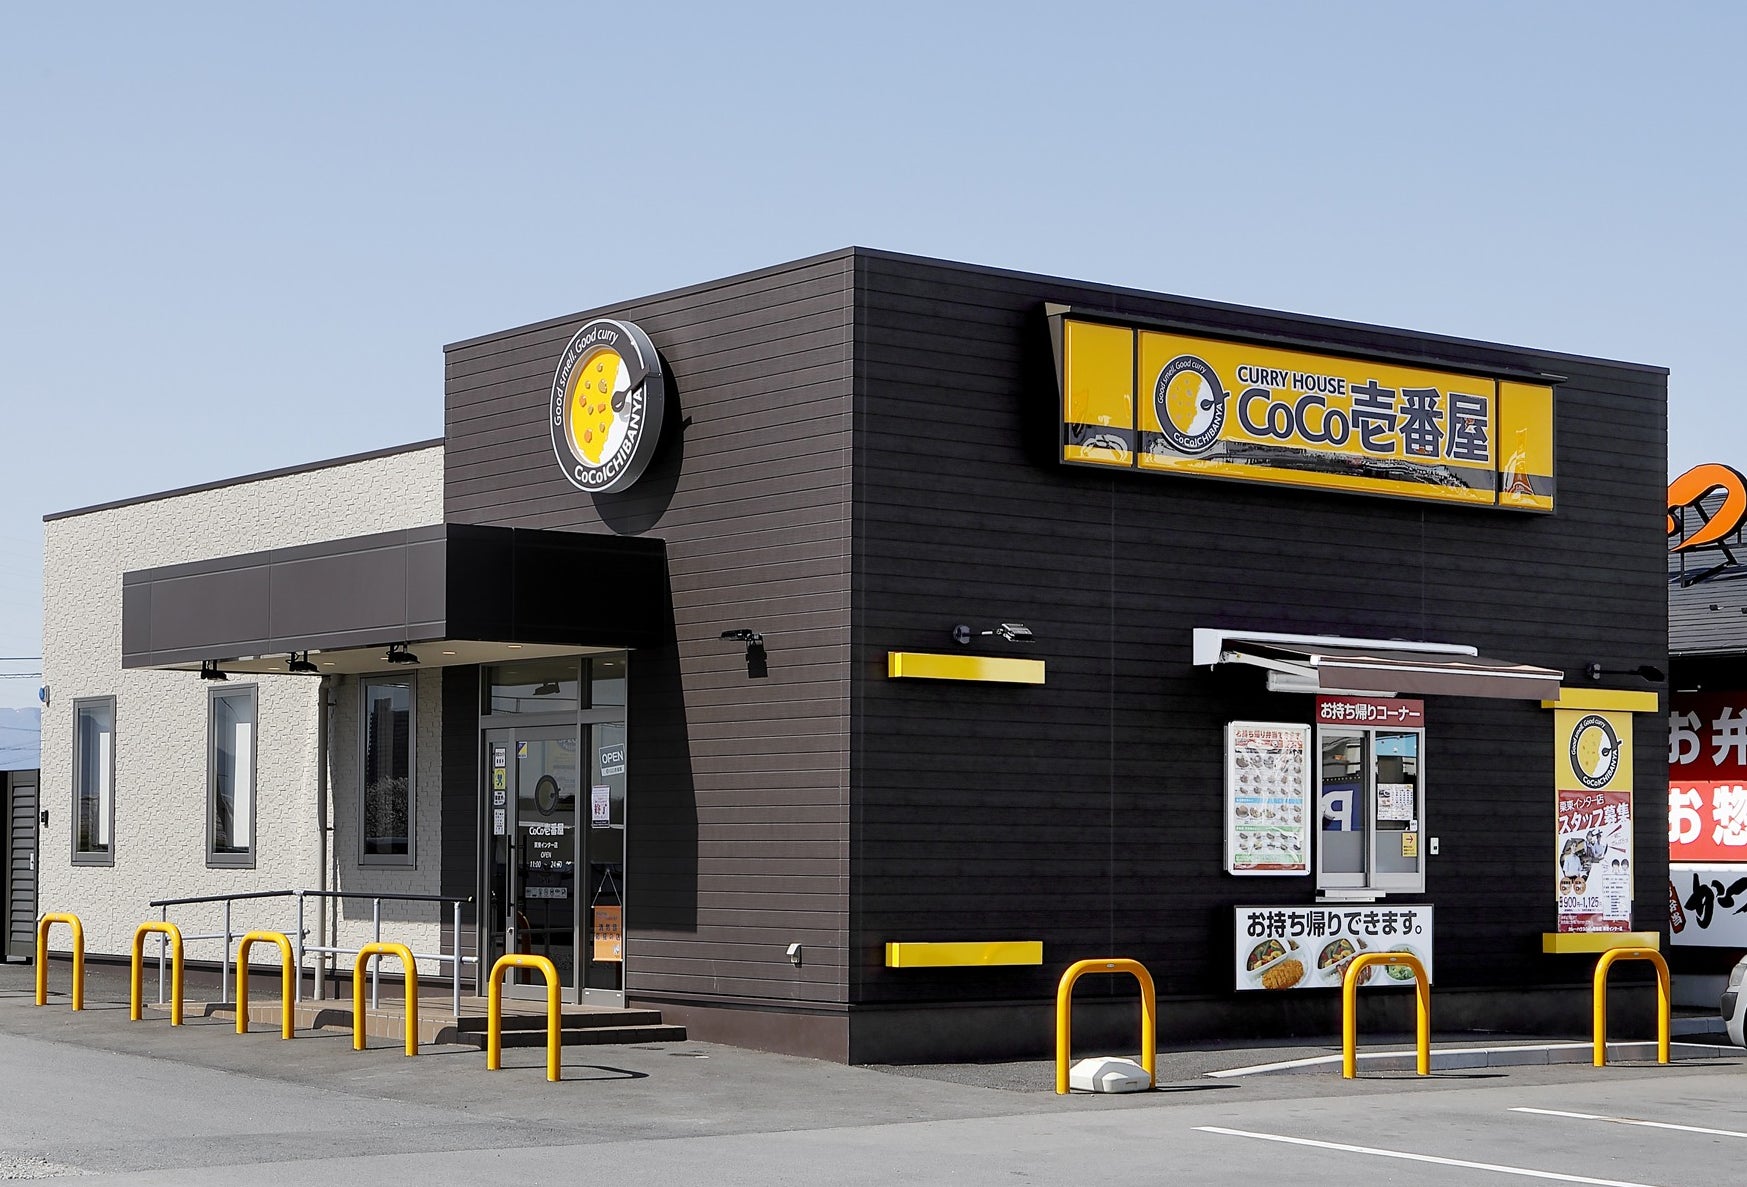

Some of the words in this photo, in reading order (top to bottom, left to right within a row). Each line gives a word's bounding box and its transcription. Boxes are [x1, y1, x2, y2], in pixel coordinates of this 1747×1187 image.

[554, 386, 563, 426] Good
[560, 350, 577, 387] smell.
[575, 327, 597, 352] Good
[597, 329, 619, 345] curry
[1158, 381, 1166, 404] Good
[1175, 359, 1191, 370] Good
[1191, 361, 1207, 374] curry
[1237, 365, 1289, 389] CURRY
[1293, 371, 1346, 396] HOUSE
[1238, 379, 1489, 462] CoCo壱番屋
[1320, 702, 1421, 721] お持ち帰りコーナー
[601, 750, 624, 764] OPEN
[1558, 802, 1630, 835] スタッフ募集
[1246, 910, 1423, 938] お持ち帰りできます。
